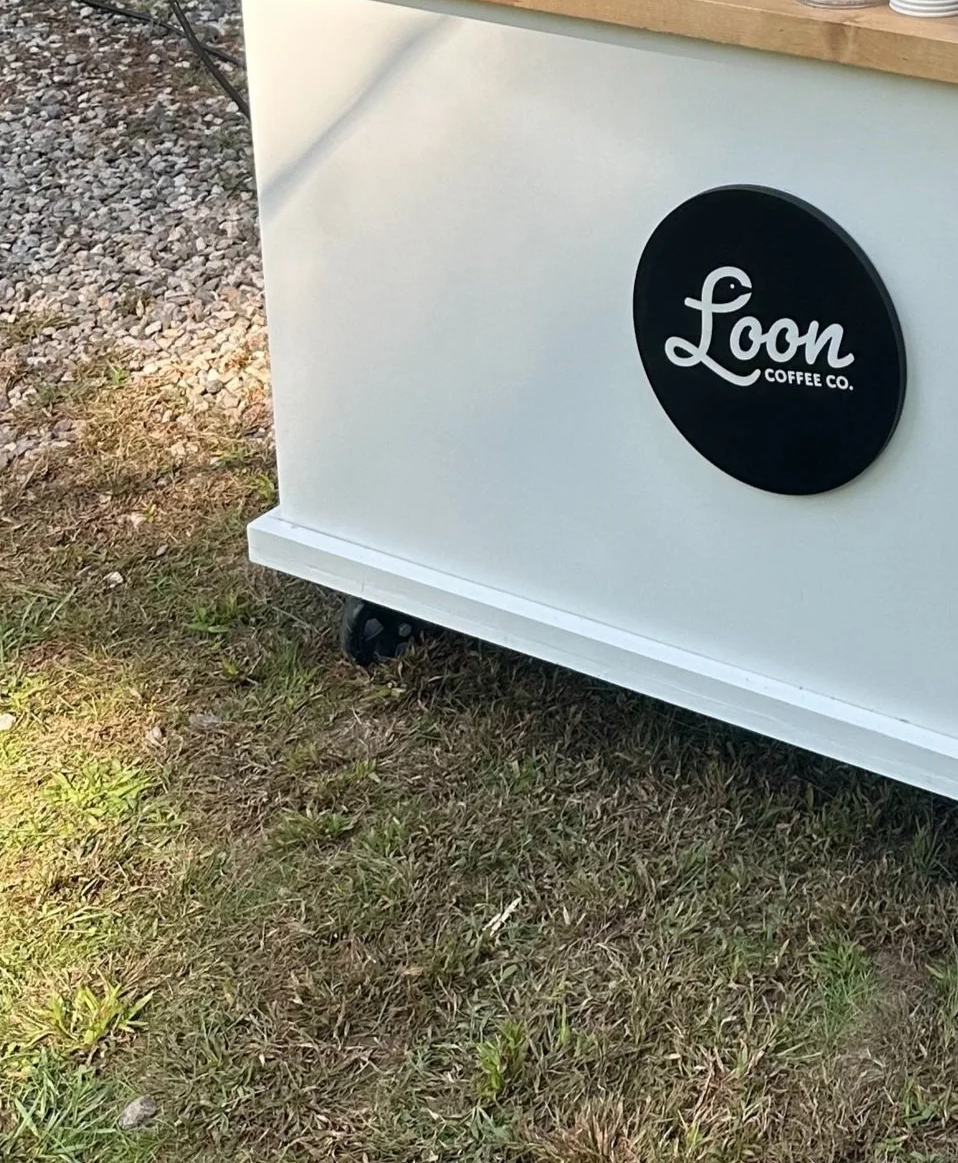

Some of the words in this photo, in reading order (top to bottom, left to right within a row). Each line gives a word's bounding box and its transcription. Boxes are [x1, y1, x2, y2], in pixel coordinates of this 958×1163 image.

[664, 266, 855, 387] Loon
[764, 368, 822, 387] COFFEE
[826, 375, 854, 390] CO.
